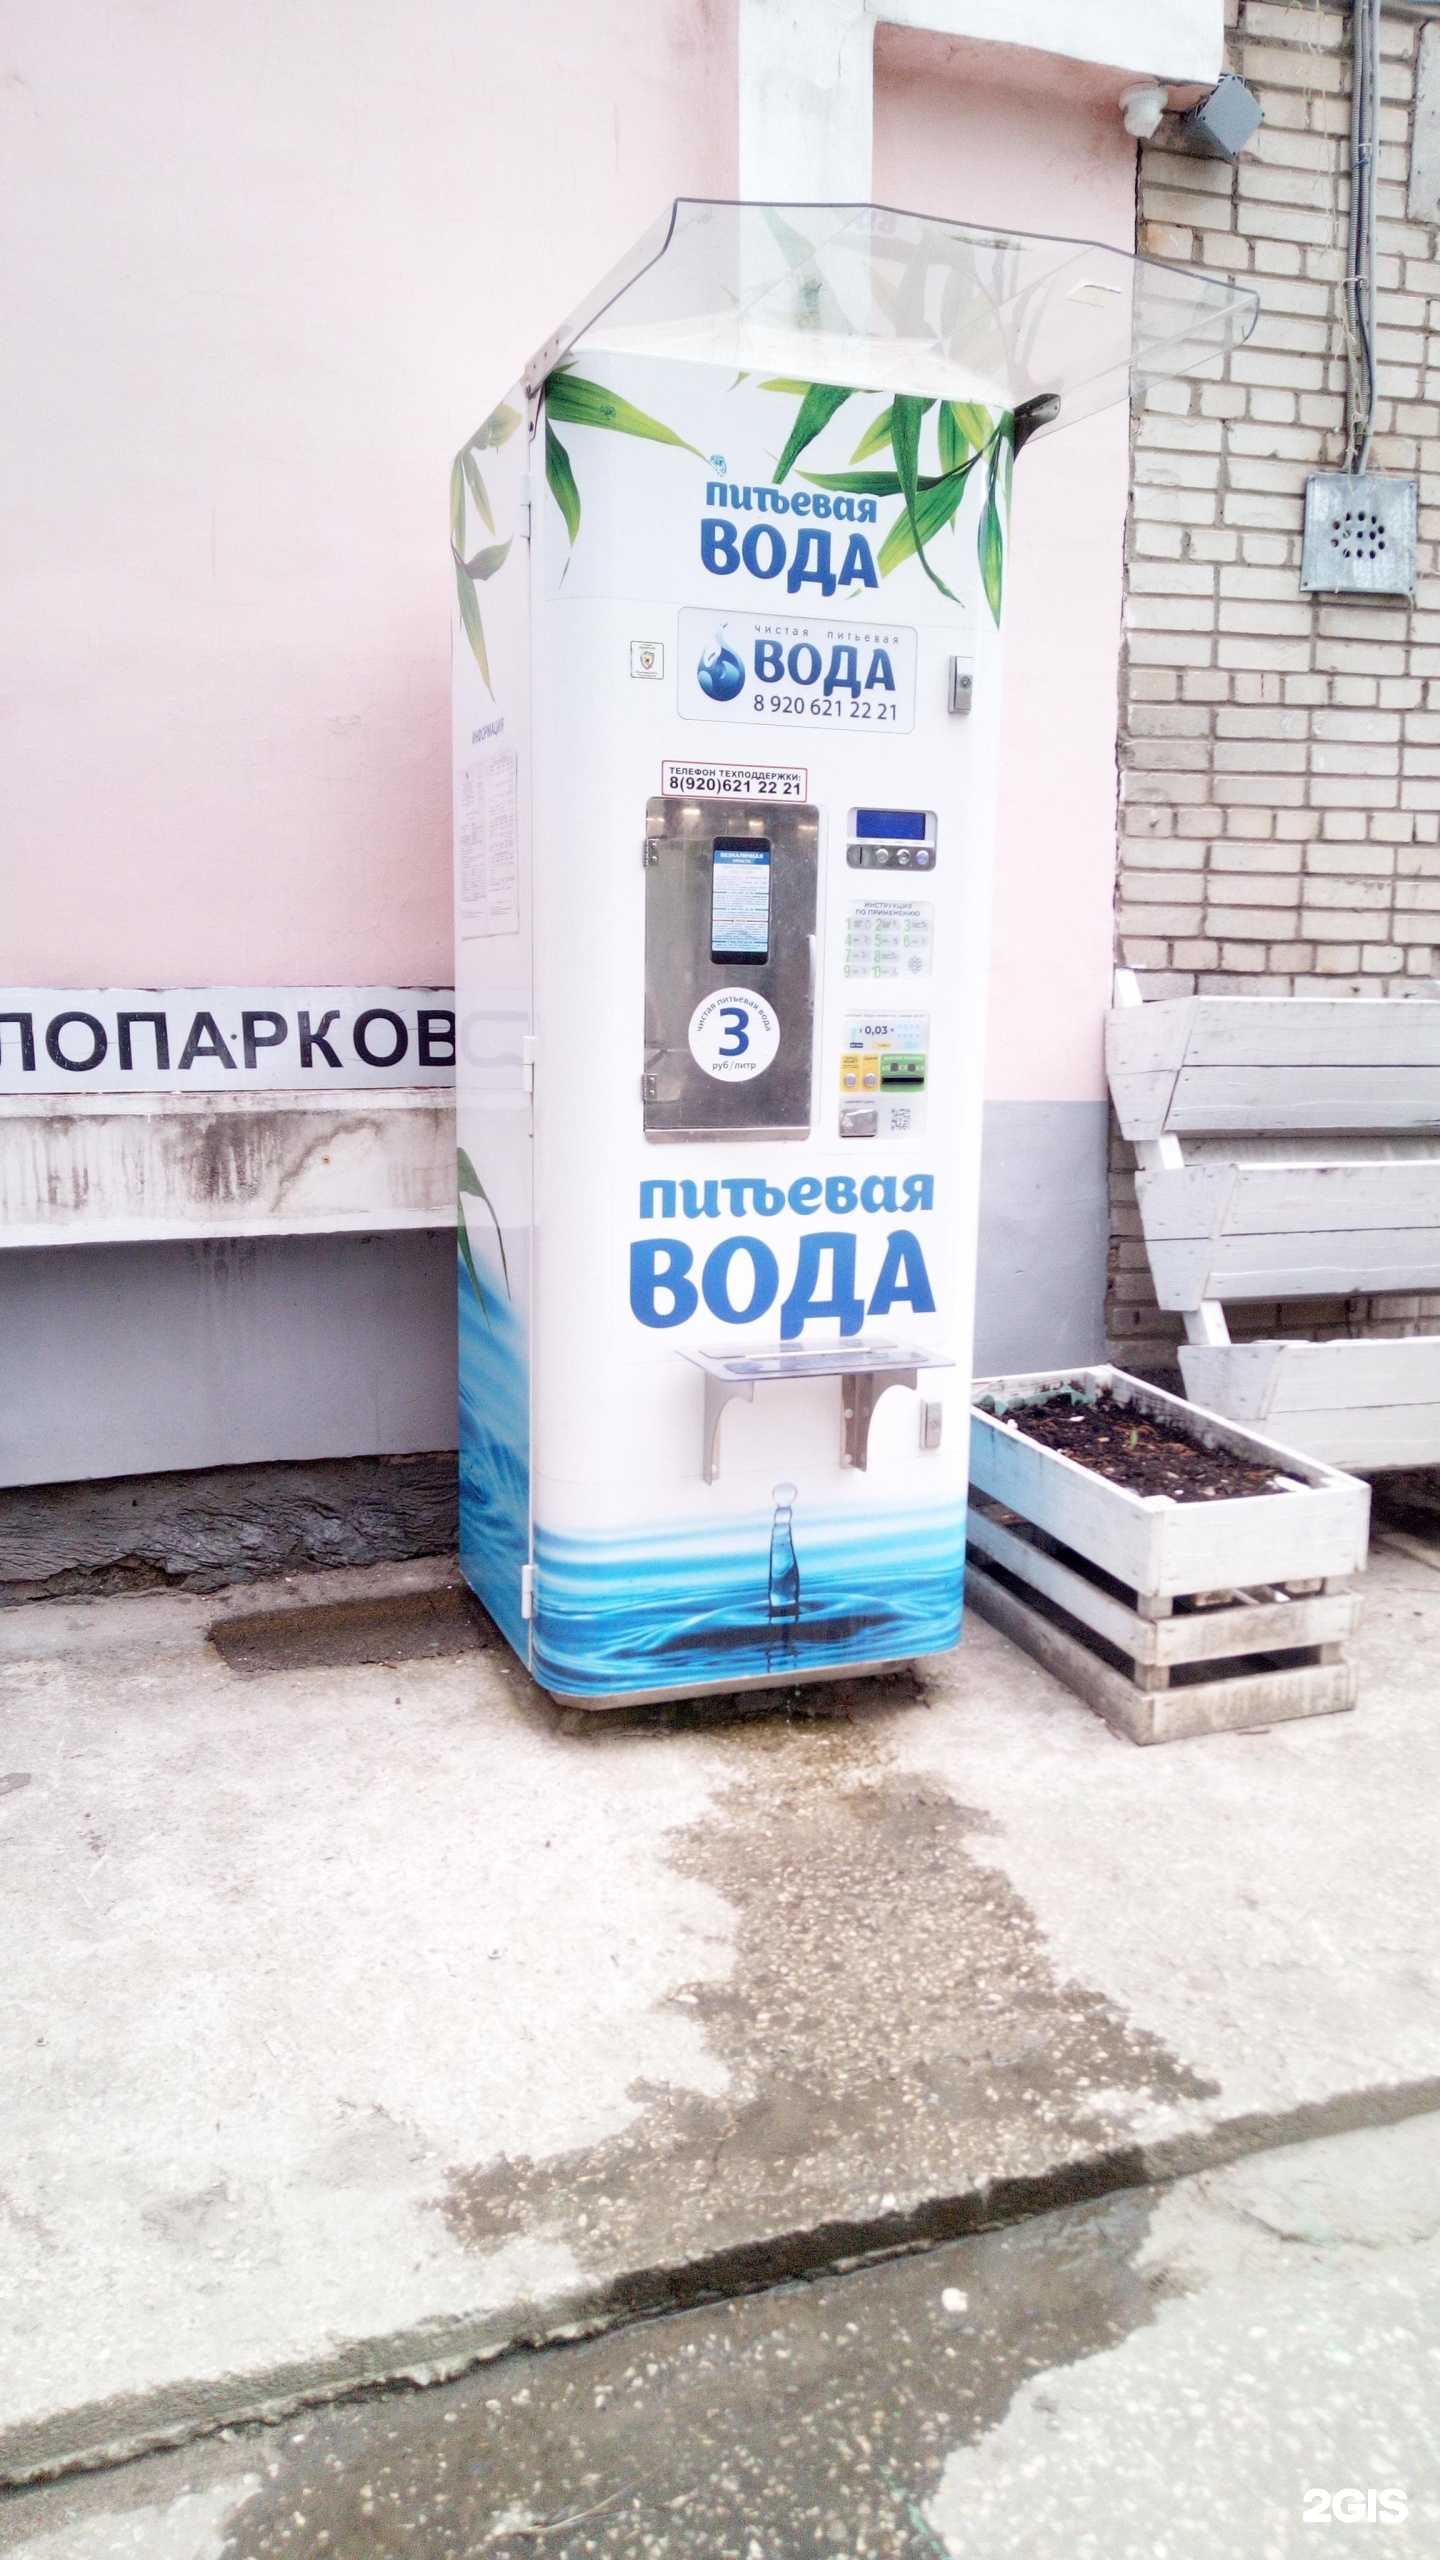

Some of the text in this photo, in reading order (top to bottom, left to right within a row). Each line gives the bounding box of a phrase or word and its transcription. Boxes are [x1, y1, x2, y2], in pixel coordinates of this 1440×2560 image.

[706, 481, 878, 524] питьевая
[700, 518, 879, 597] ВОДА
[754, 625, 900, 644] чистая питьевая
[754, 639, 896, 699] ВОДА
[754, 694, 896, 721] 8 920 621 22 21
[669, 766, 716, 777] ТЕЛЕФОН
[669, 776, 800, 795] 8(920)621 22 21
[718, 1007, 750, 1057] 3
[639, 1173, 935, 1219] питьевая
[630, 1229, 937, 1341] ВОДА
